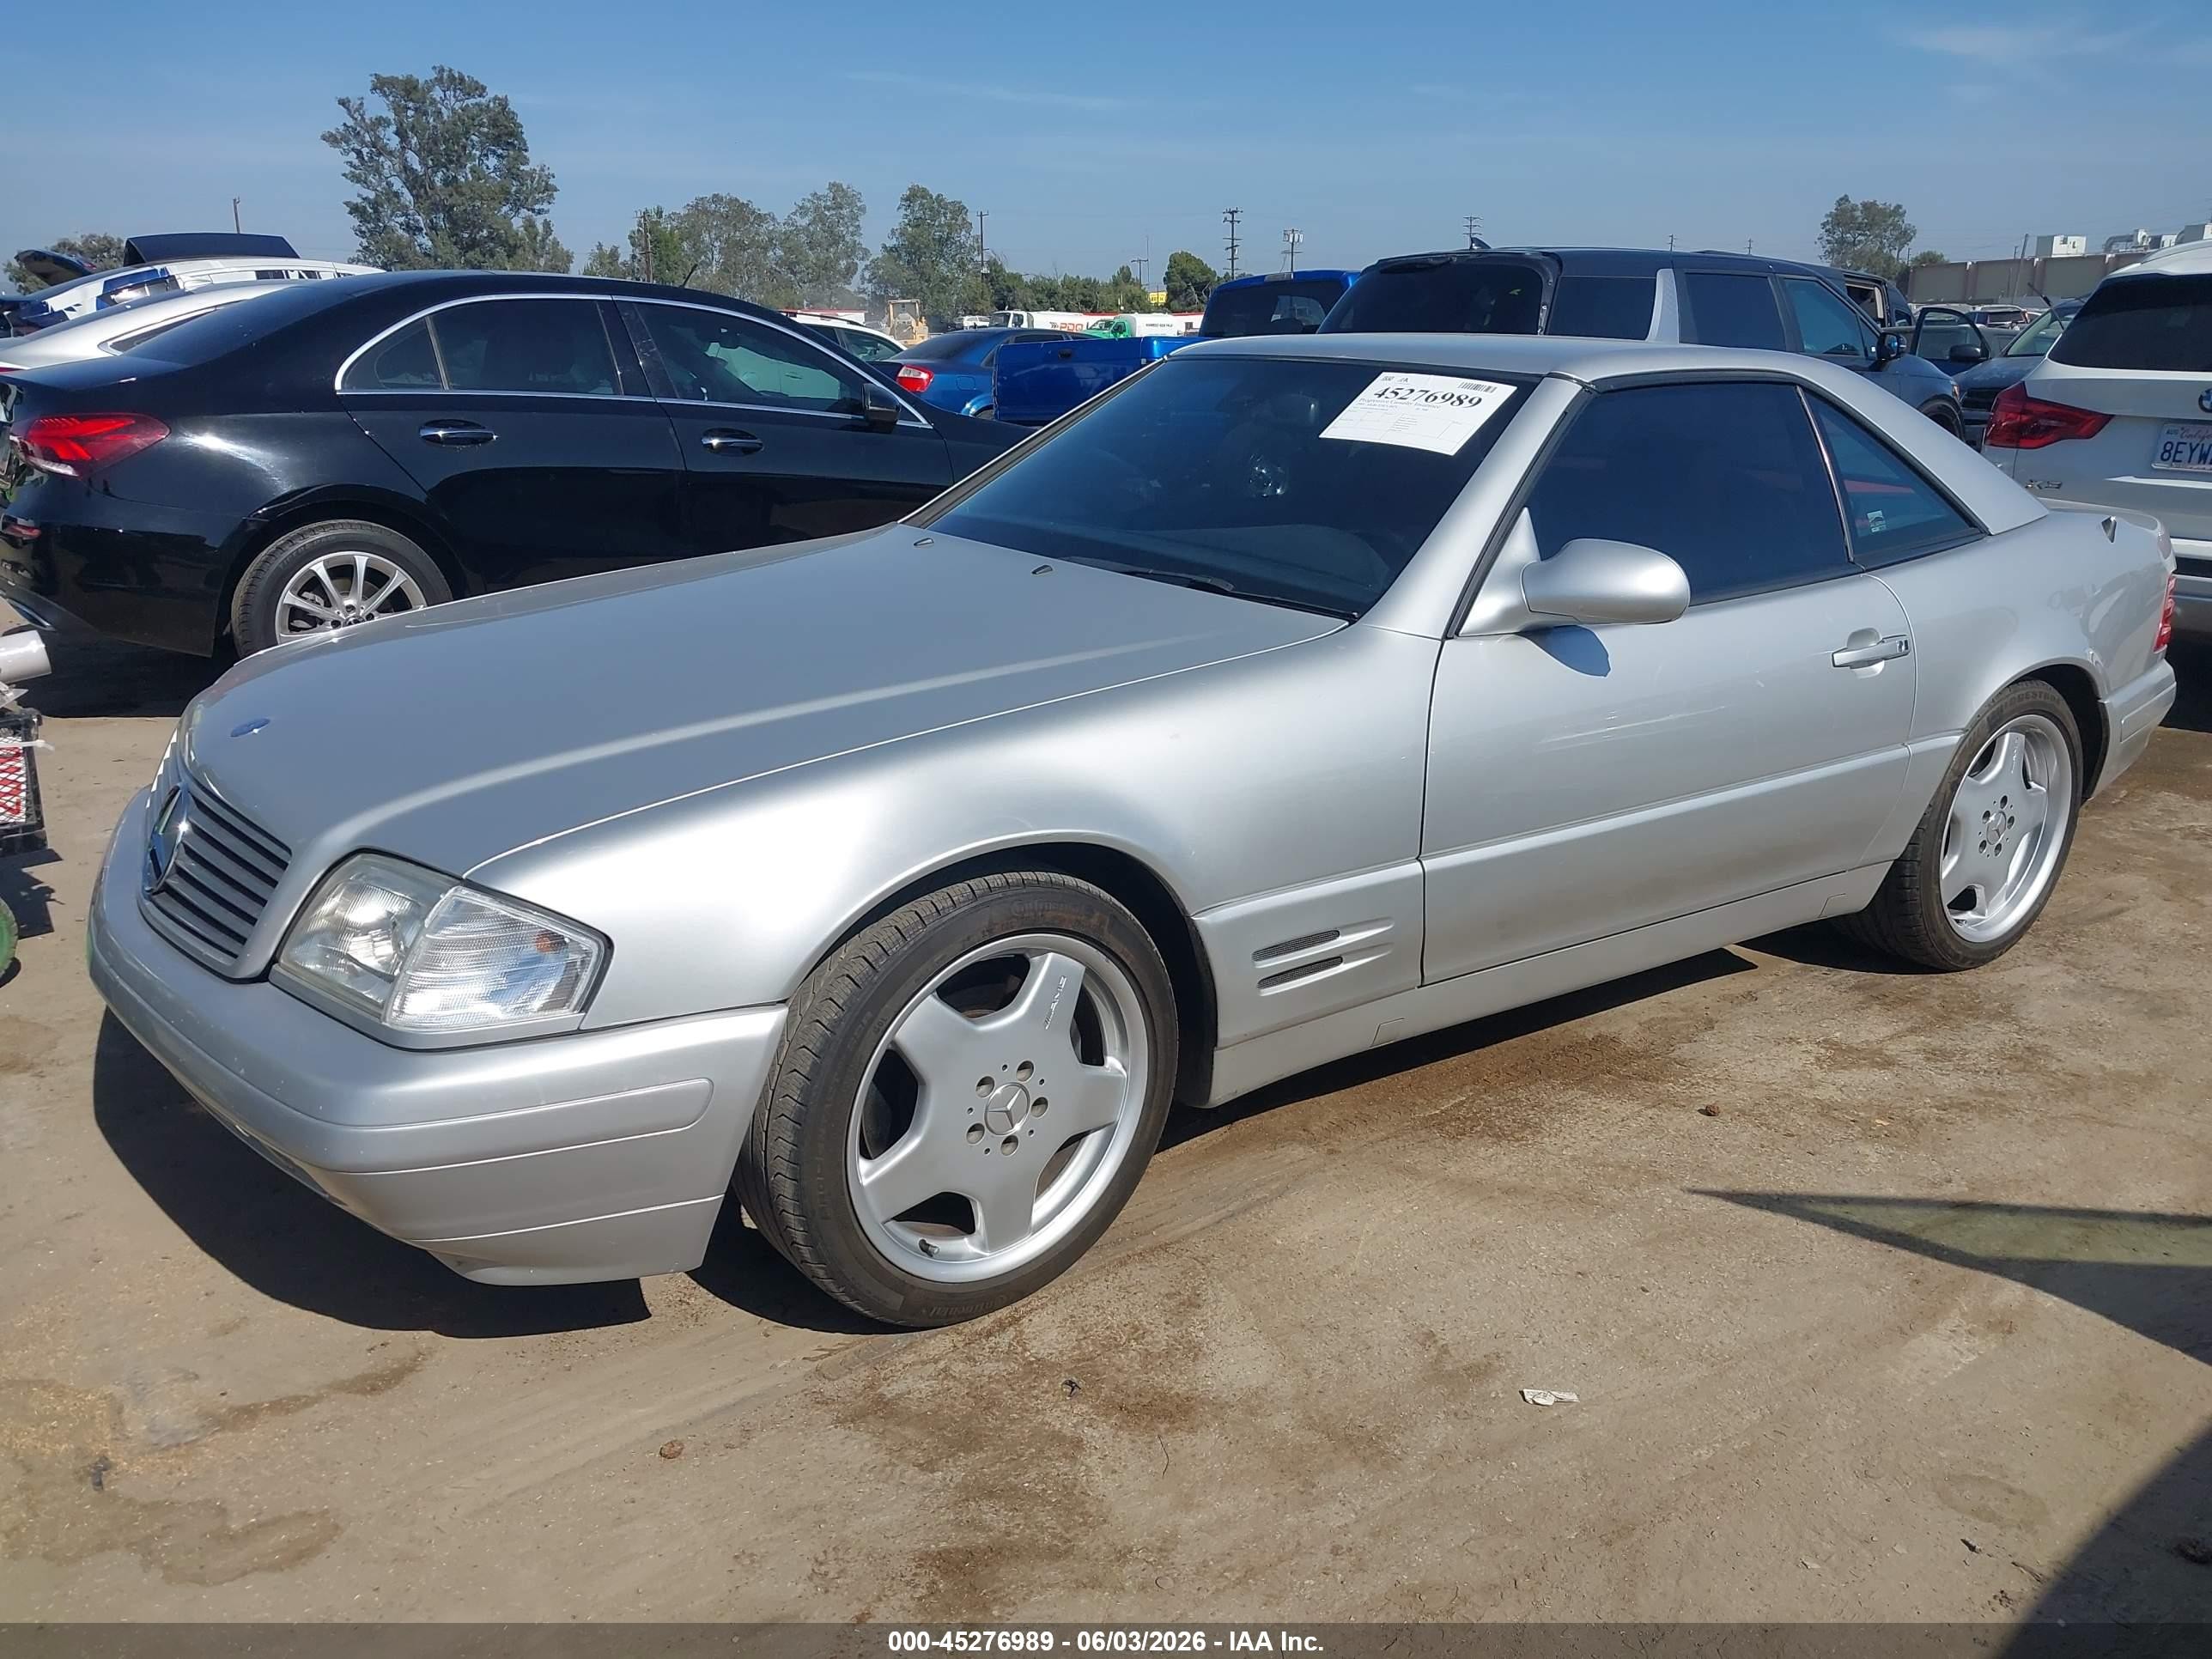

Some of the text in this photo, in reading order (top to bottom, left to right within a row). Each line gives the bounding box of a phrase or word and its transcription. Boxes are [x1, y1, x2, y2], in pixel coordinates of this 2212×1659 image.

[1060, 322, 1084, 331] PDQ
[1374, 386, 1482, 408] 45276989
[2160, 441, 2212, 465] 8EYW
